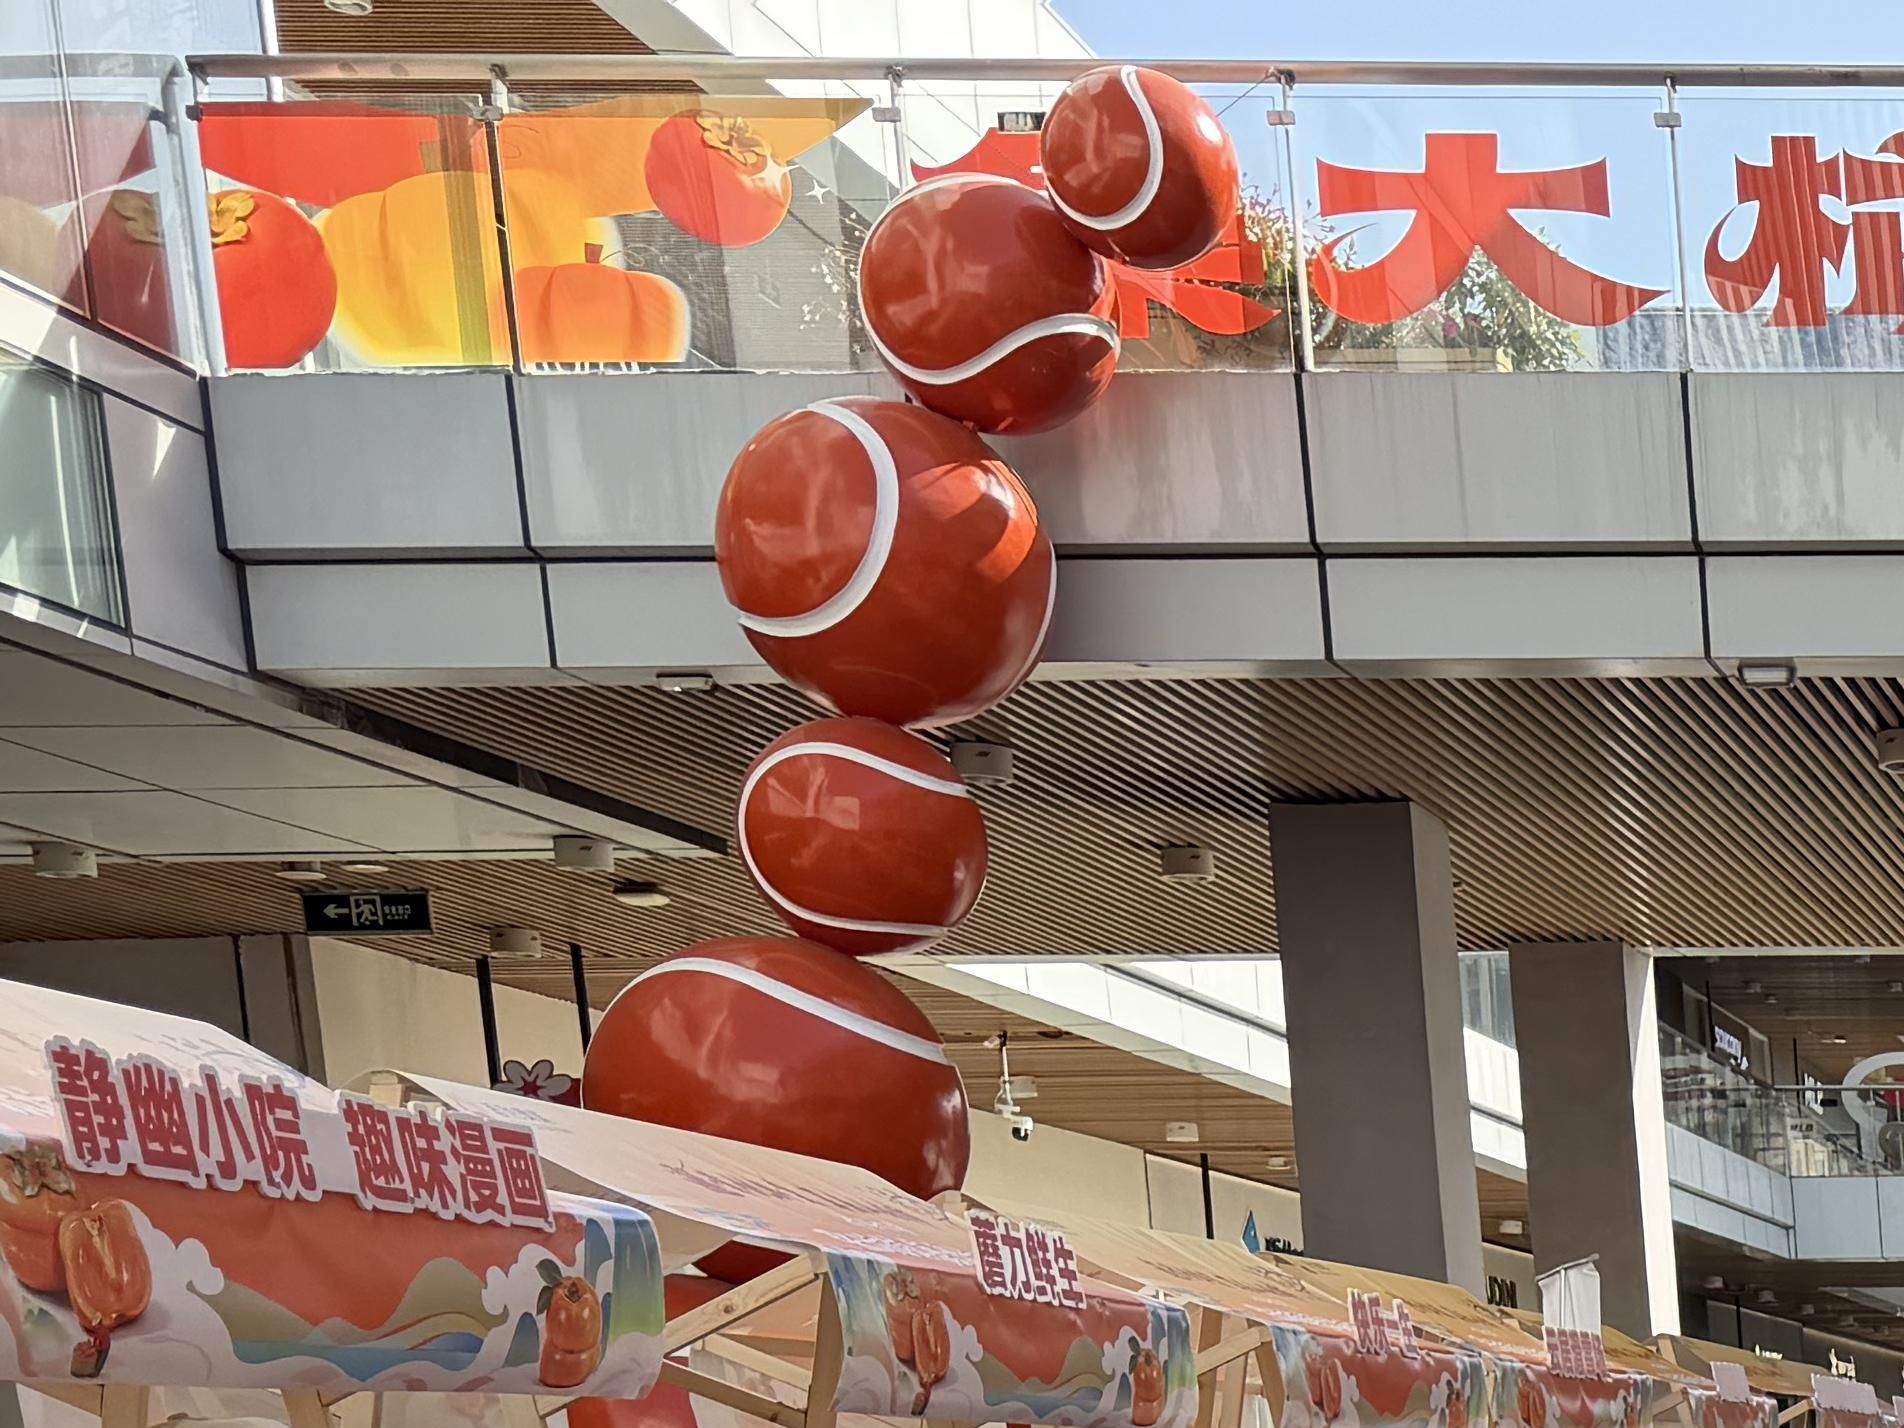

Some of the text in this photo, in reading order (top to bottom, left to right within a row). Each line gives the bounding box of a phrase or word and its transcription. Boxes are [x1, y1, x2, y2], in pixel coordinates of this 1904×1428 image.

[52, 1044, 553, 1228] 静幽小院 趣味漫画
[969, 1215, 1084, 1304] 蘑力鲜生
